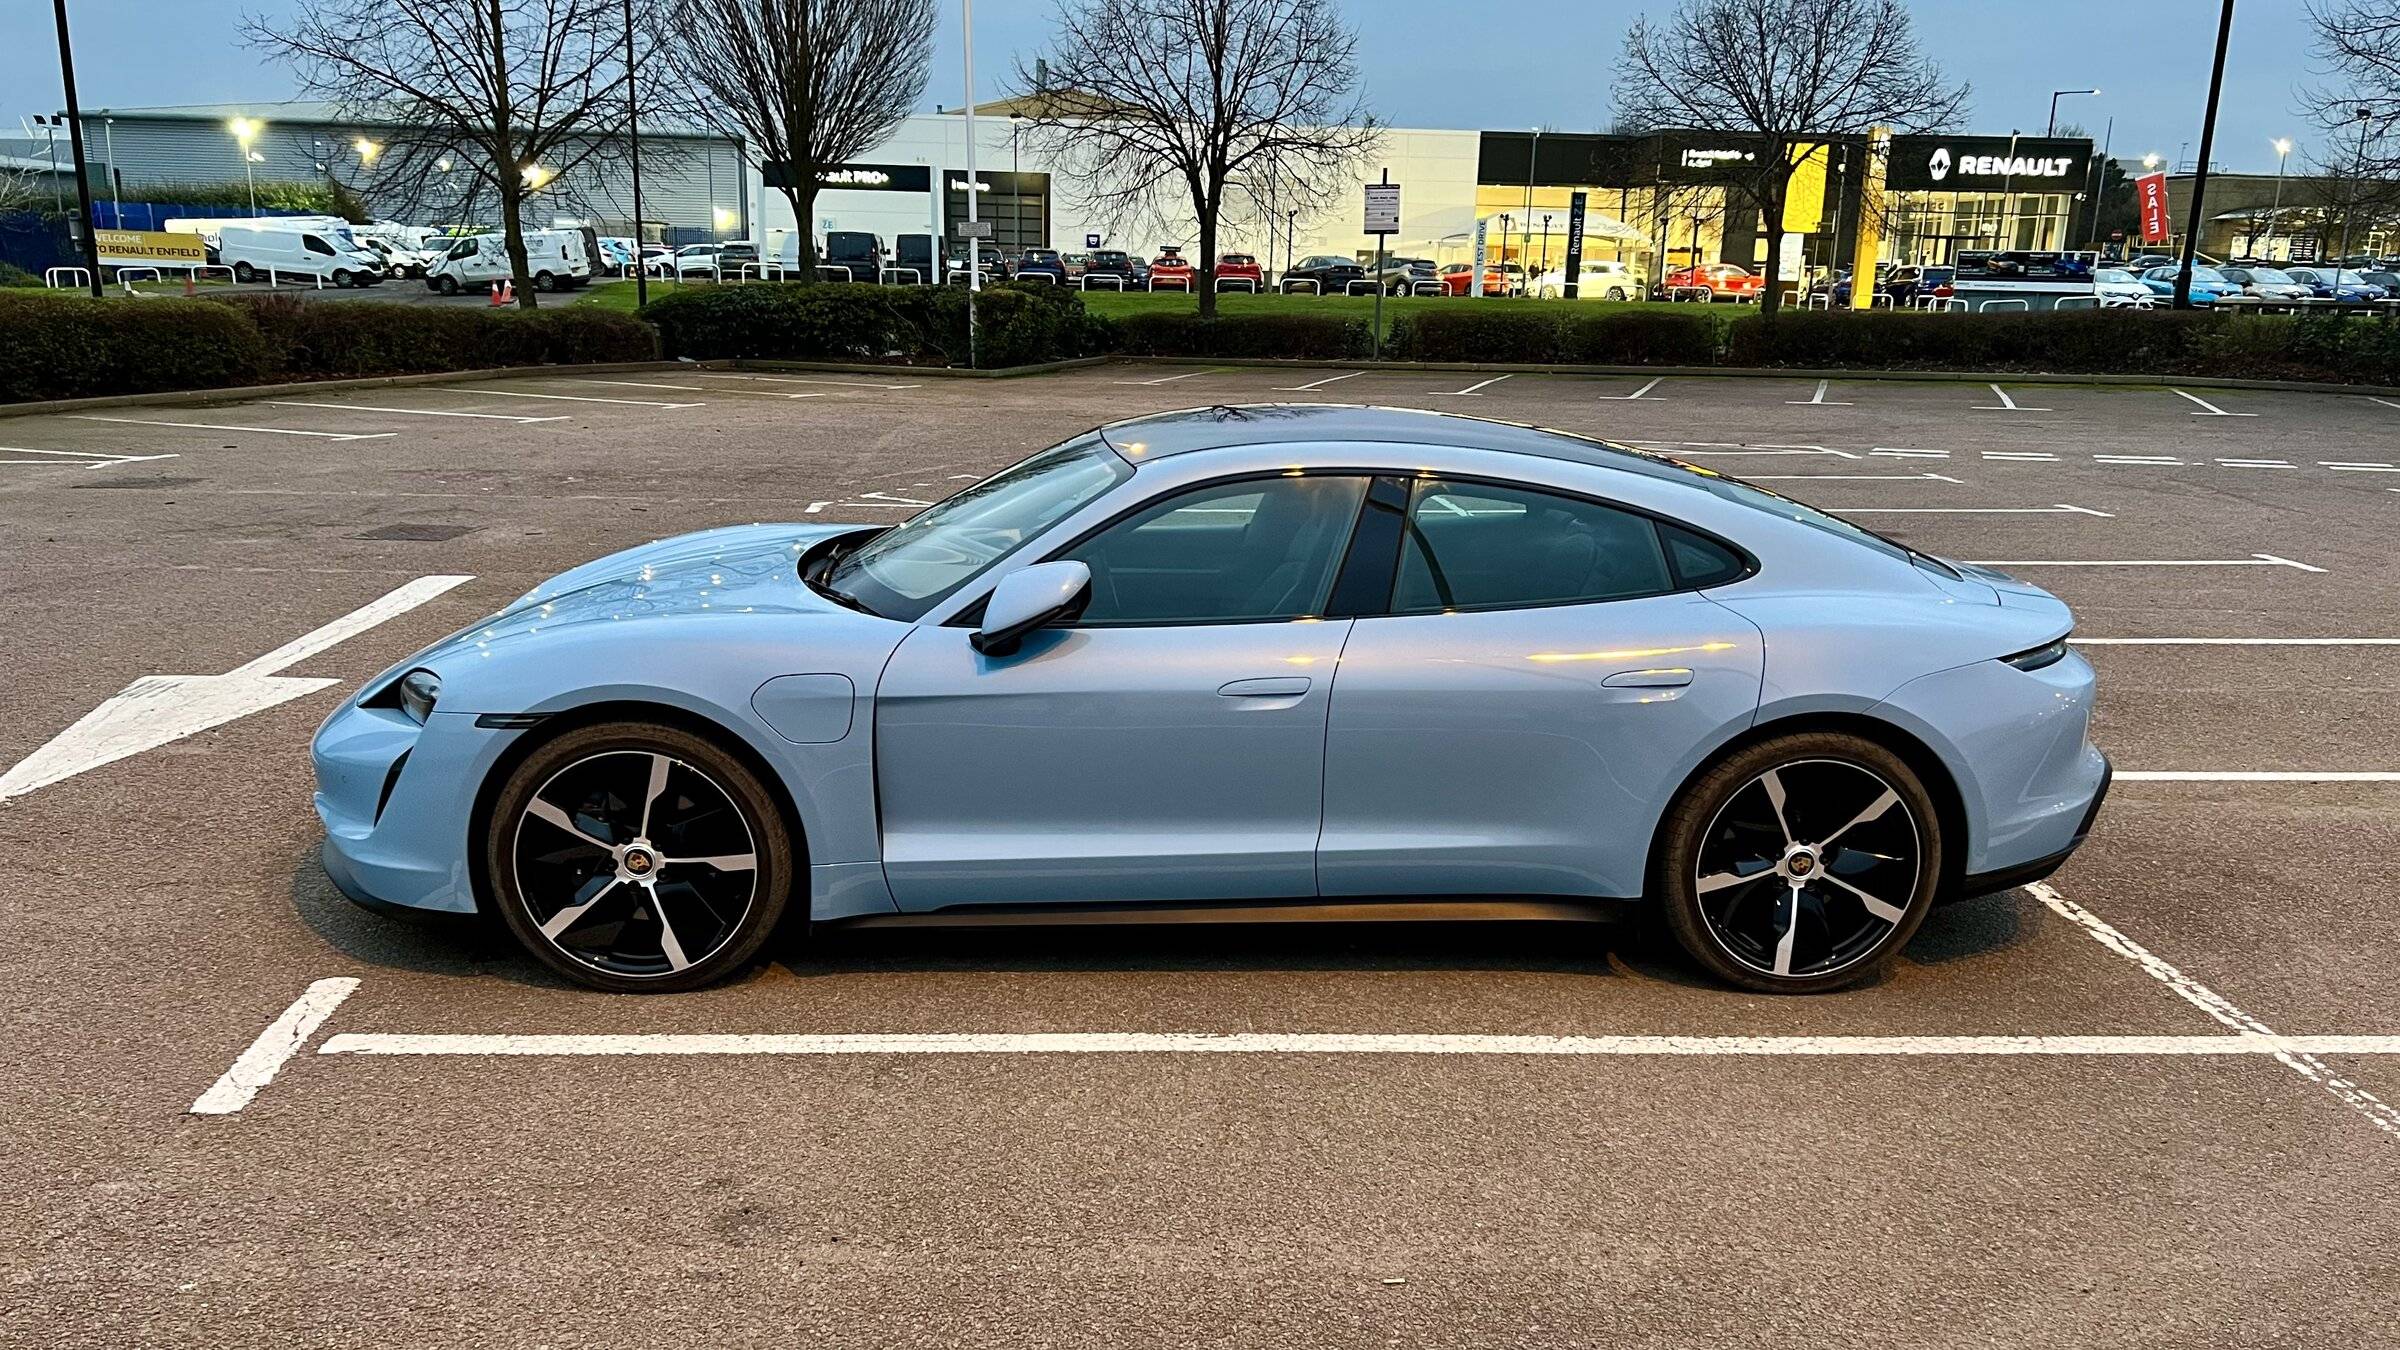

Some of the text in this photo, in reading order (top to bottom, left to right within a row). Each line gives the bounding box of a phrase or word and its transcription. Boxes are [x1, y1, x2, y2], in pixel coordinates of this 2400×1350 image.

[1958, 154, 2073, 177] RENAULT
[108, 245, 154, 256] RENAULT
[156, 247, 201, 257] ENFIELD
[1476, 220, 1487, 266] TEST DRIVE
[1570, 217, 1583, 255] Renault
